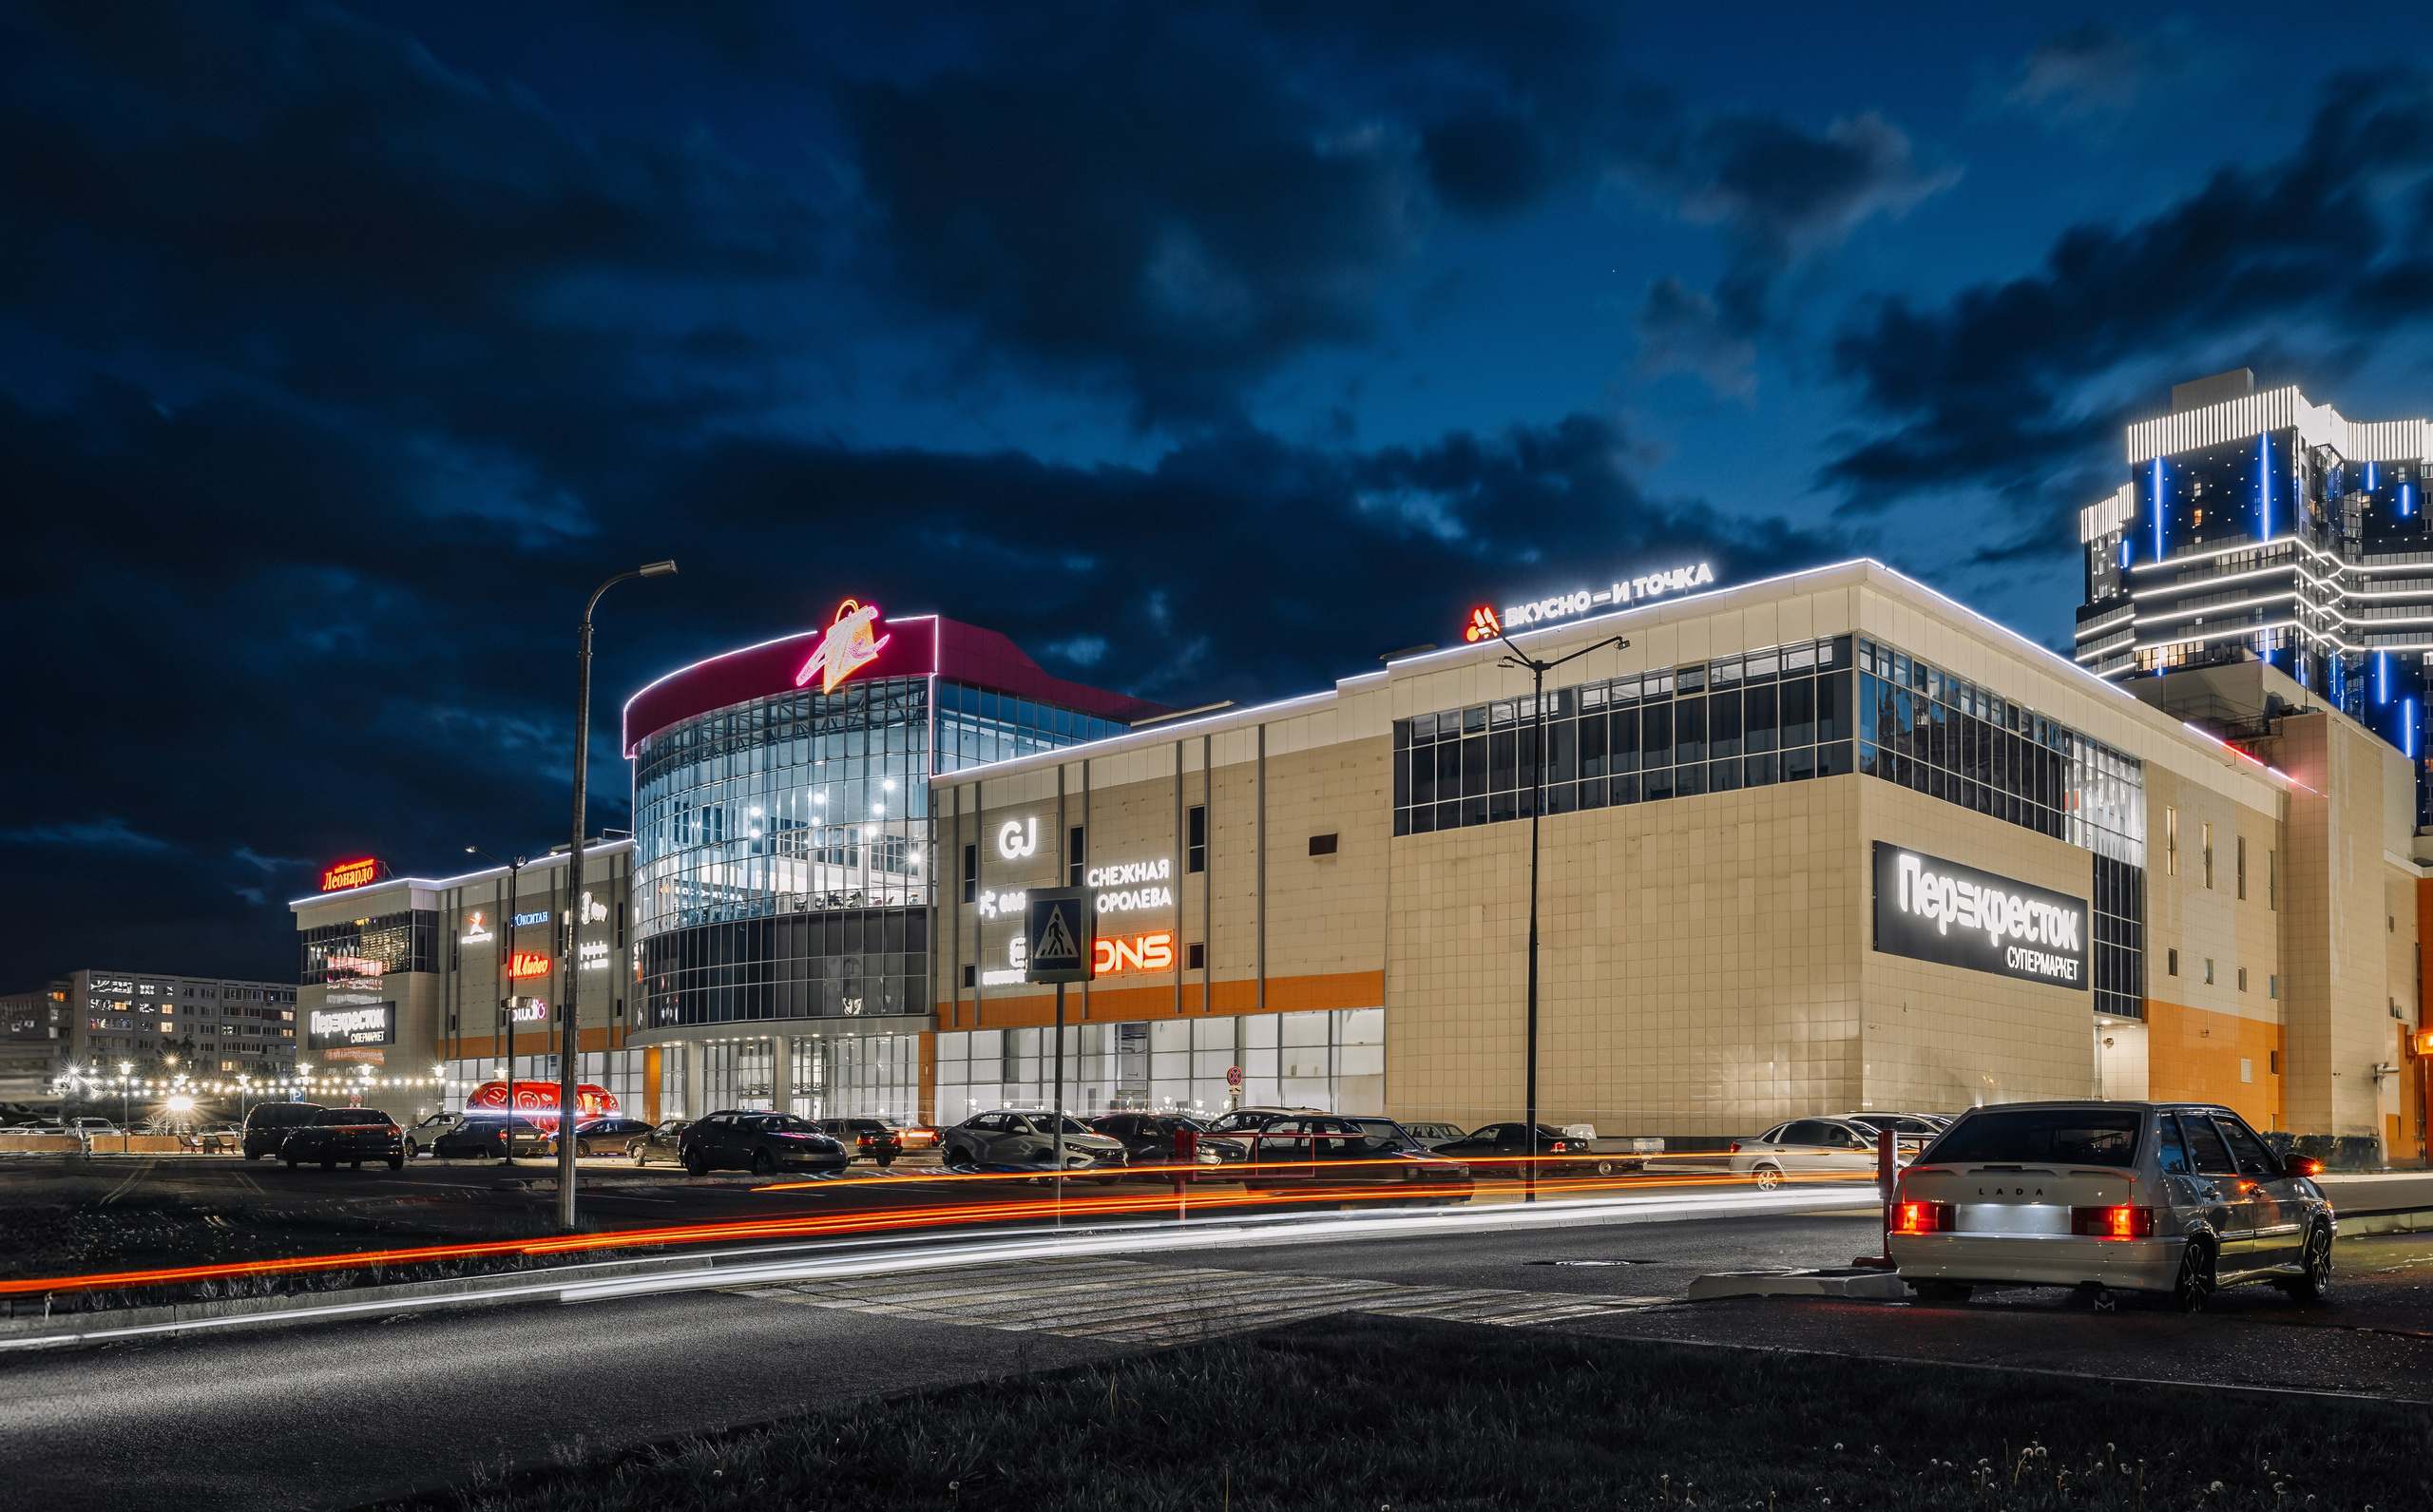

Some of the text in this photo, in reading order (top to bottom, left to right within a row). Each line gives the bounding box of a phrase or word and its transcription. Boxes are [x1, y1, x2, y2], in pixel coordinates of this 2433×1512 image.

[1633, 563, 1714, 597] ТОЧКА
[999, 817, 1037, 859] GJ
[323, 866, 374, 891] Леонардо
[1087, 859, 1171, 888] СНЕЖНАЯ
[1096, 887, 1173, 913] ОРОЛЕВА
[510, 910, 549, 927] 'ОКСИТАН
[1095, 934, 1173, 974] DNS
[2006, 946, 2079, 982] СУПЕРМАРКЕТ
[351, 1030, 385, 1043] СУПЕРМАРКЕТ
[1978, 1187, 2043, 1196] LADA
